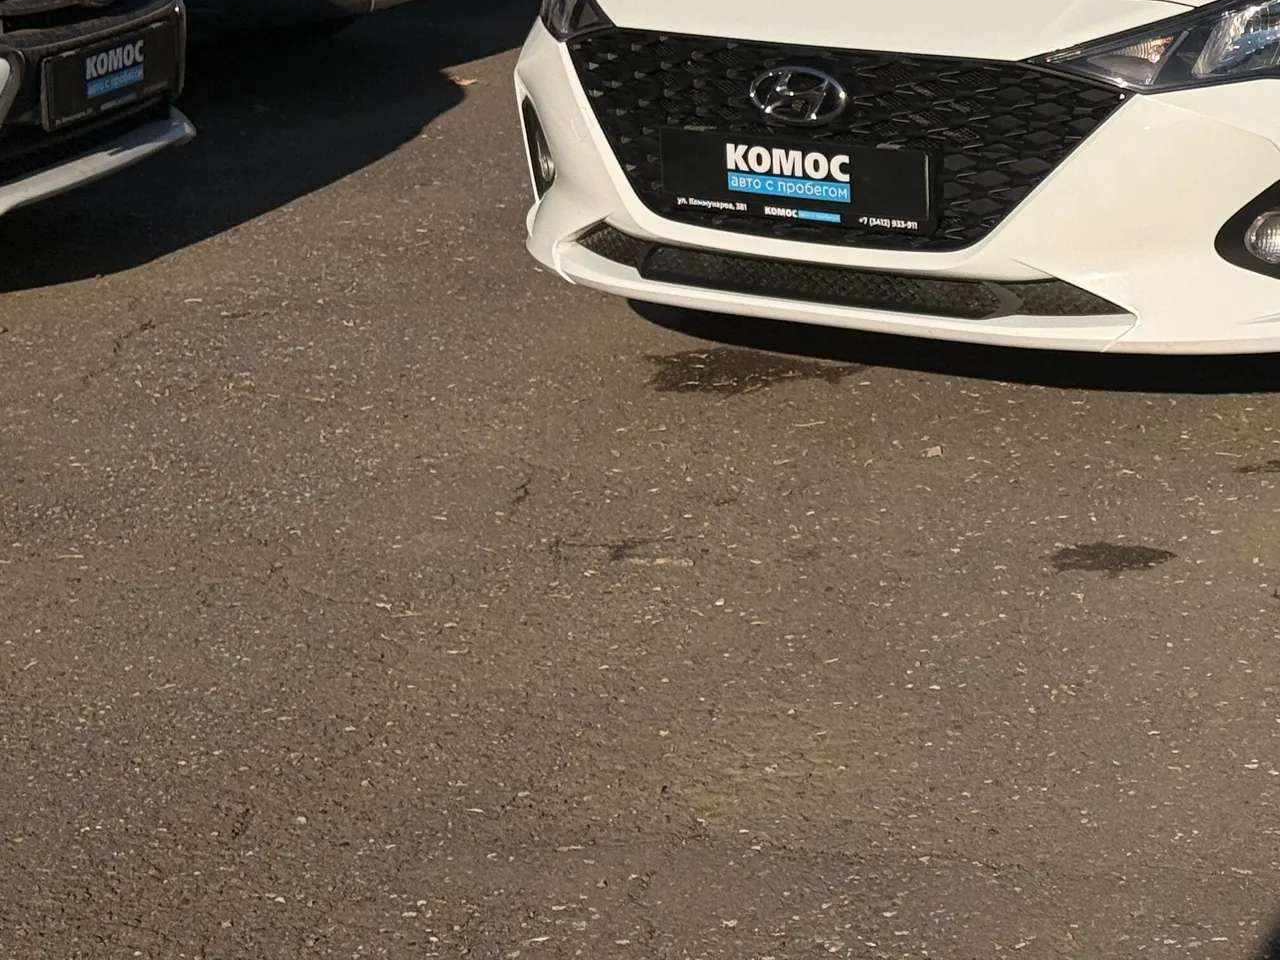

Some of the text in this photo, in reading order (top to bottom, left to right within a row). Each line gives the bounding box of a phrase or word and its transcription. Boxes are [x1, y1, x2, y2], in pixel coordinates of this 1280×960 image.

[86, 40, 145, 80] КОМОС
[726, 143, 850, 182] КОМОС
[731, 176, 848, 199] авто с пробегом
[764, 206, 798, 218] КОМОС
[858, 217, 918, 230] +7 (3412) 933-911
